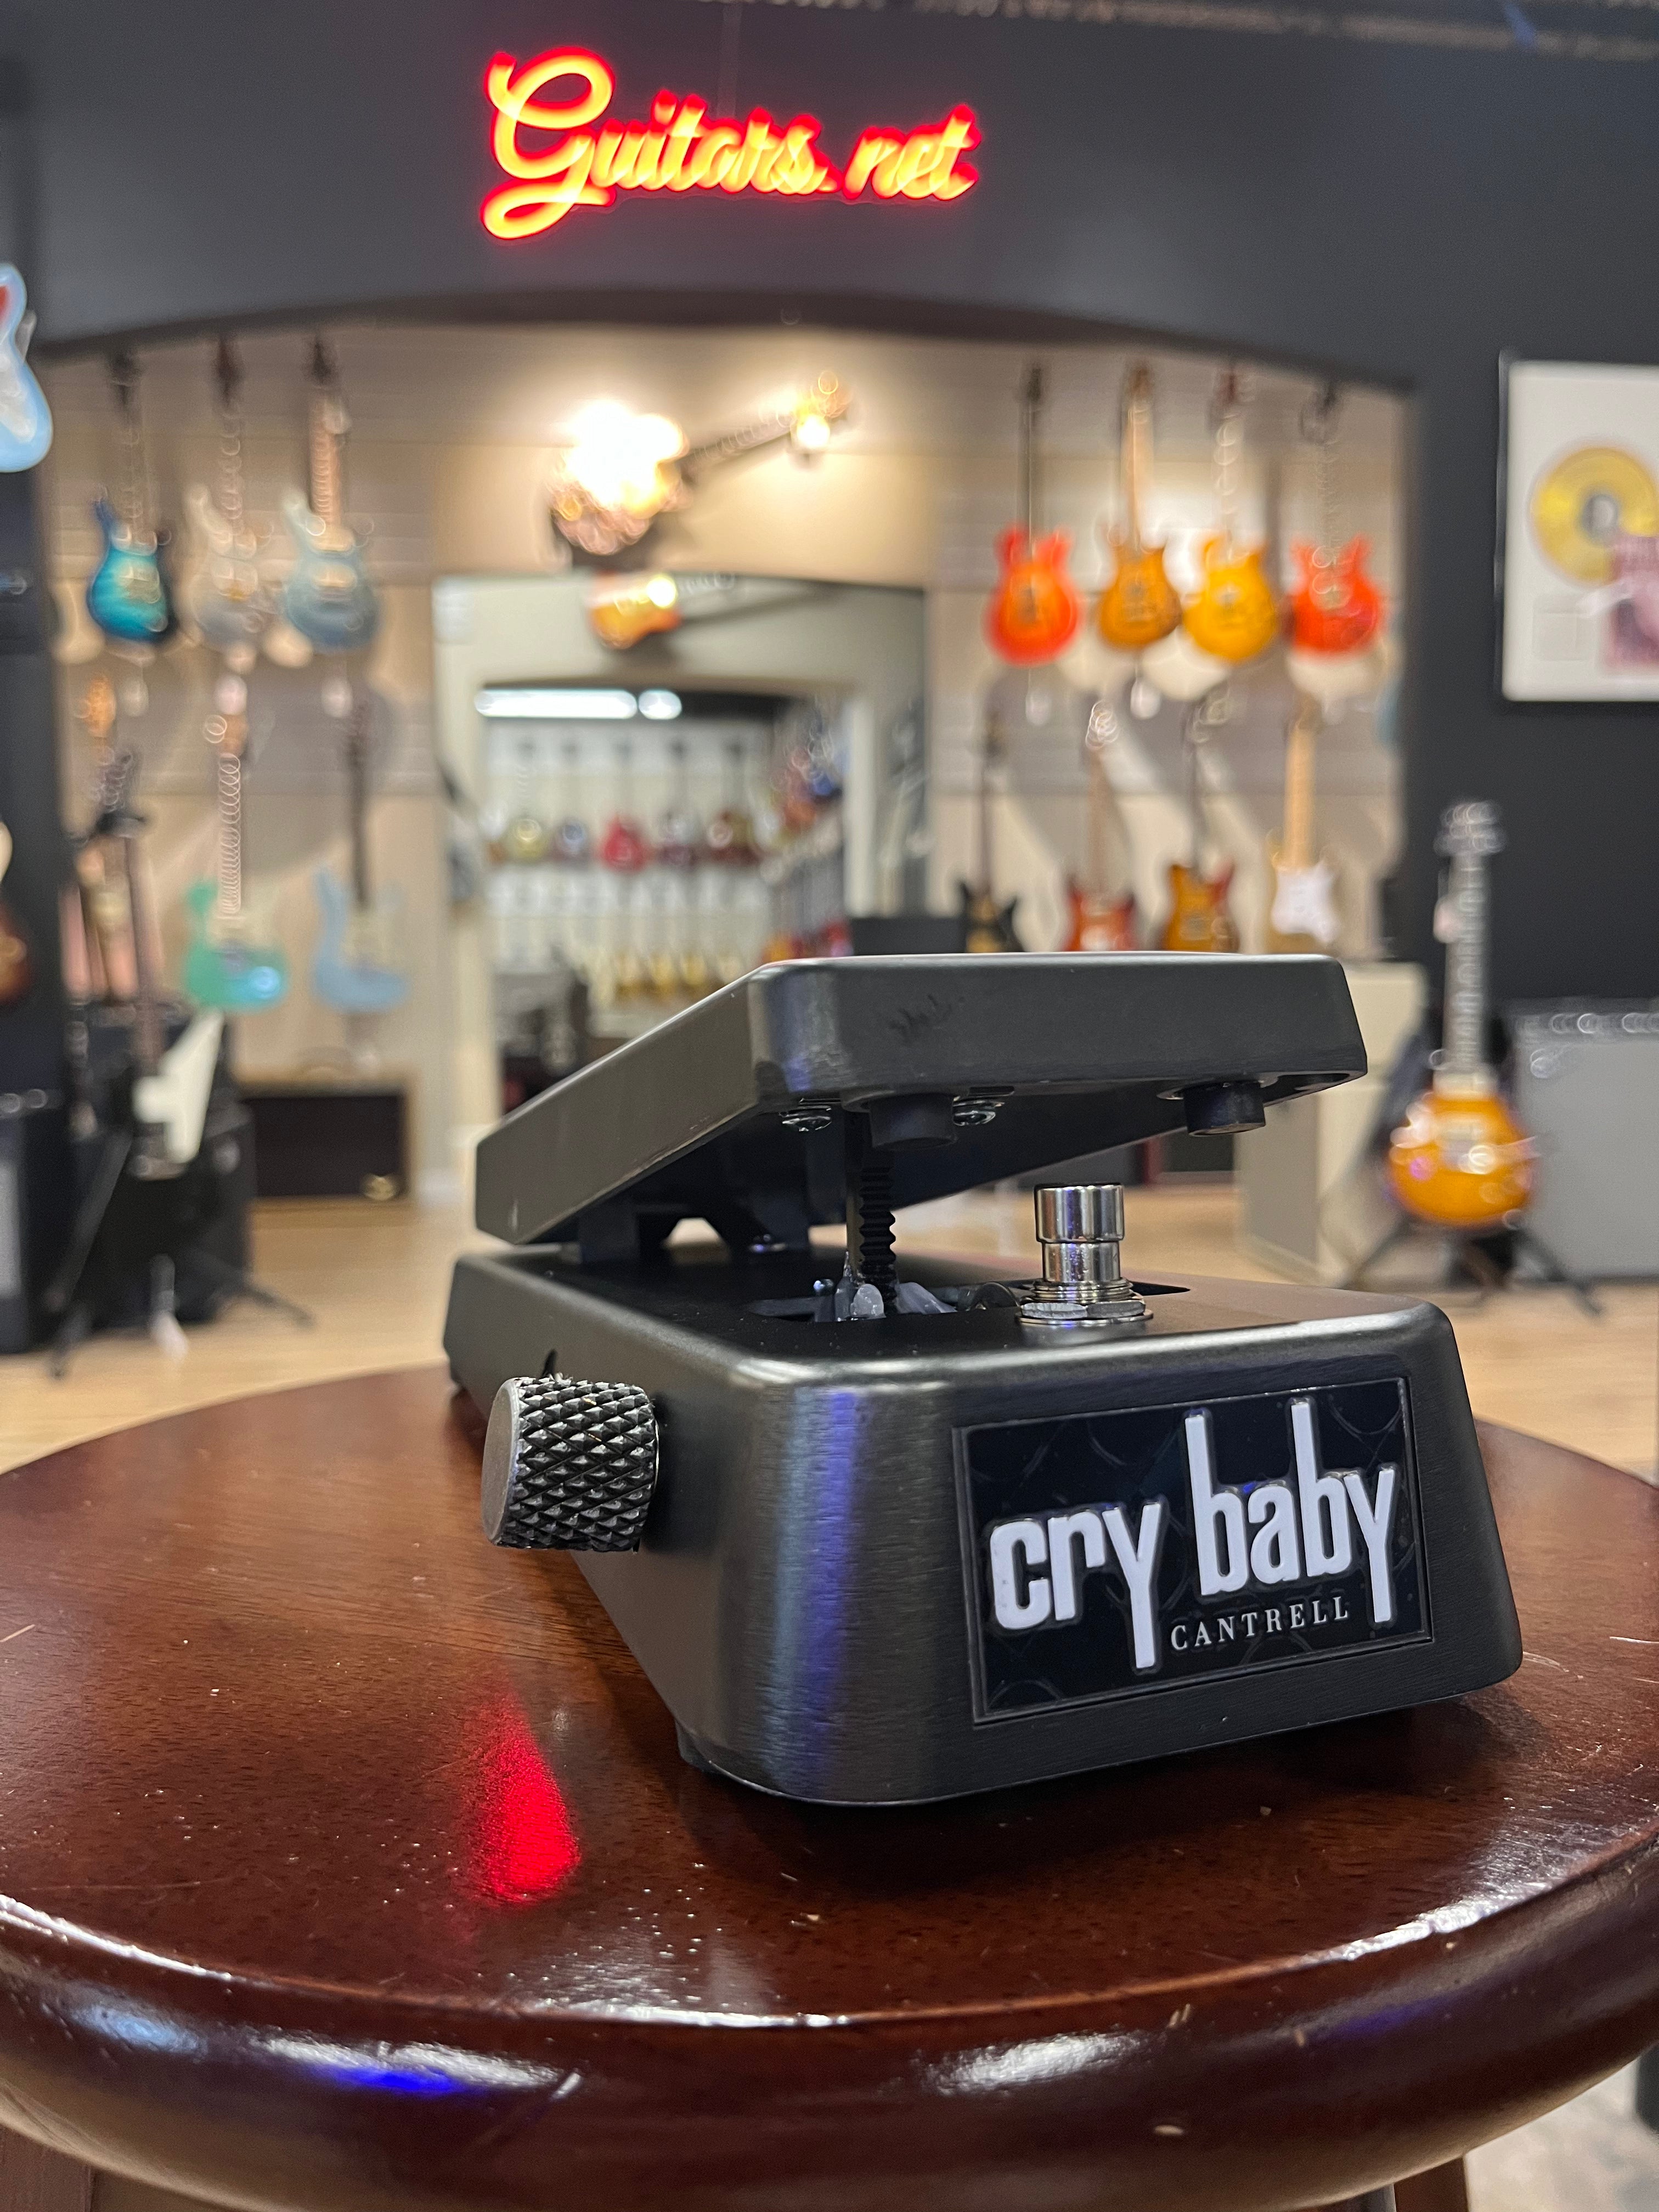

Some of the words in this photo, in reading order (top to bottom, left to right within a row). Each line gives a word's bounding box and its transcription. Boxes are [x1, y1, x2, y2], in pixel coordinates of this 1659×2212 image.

[482, 48, 981, 239] Guitars.net
[990, 1502, 1161, 1669] cry
[1185, 1400, 1396, 1623] baby
[1170, 1595, 1351, 1651] CANTRELL
